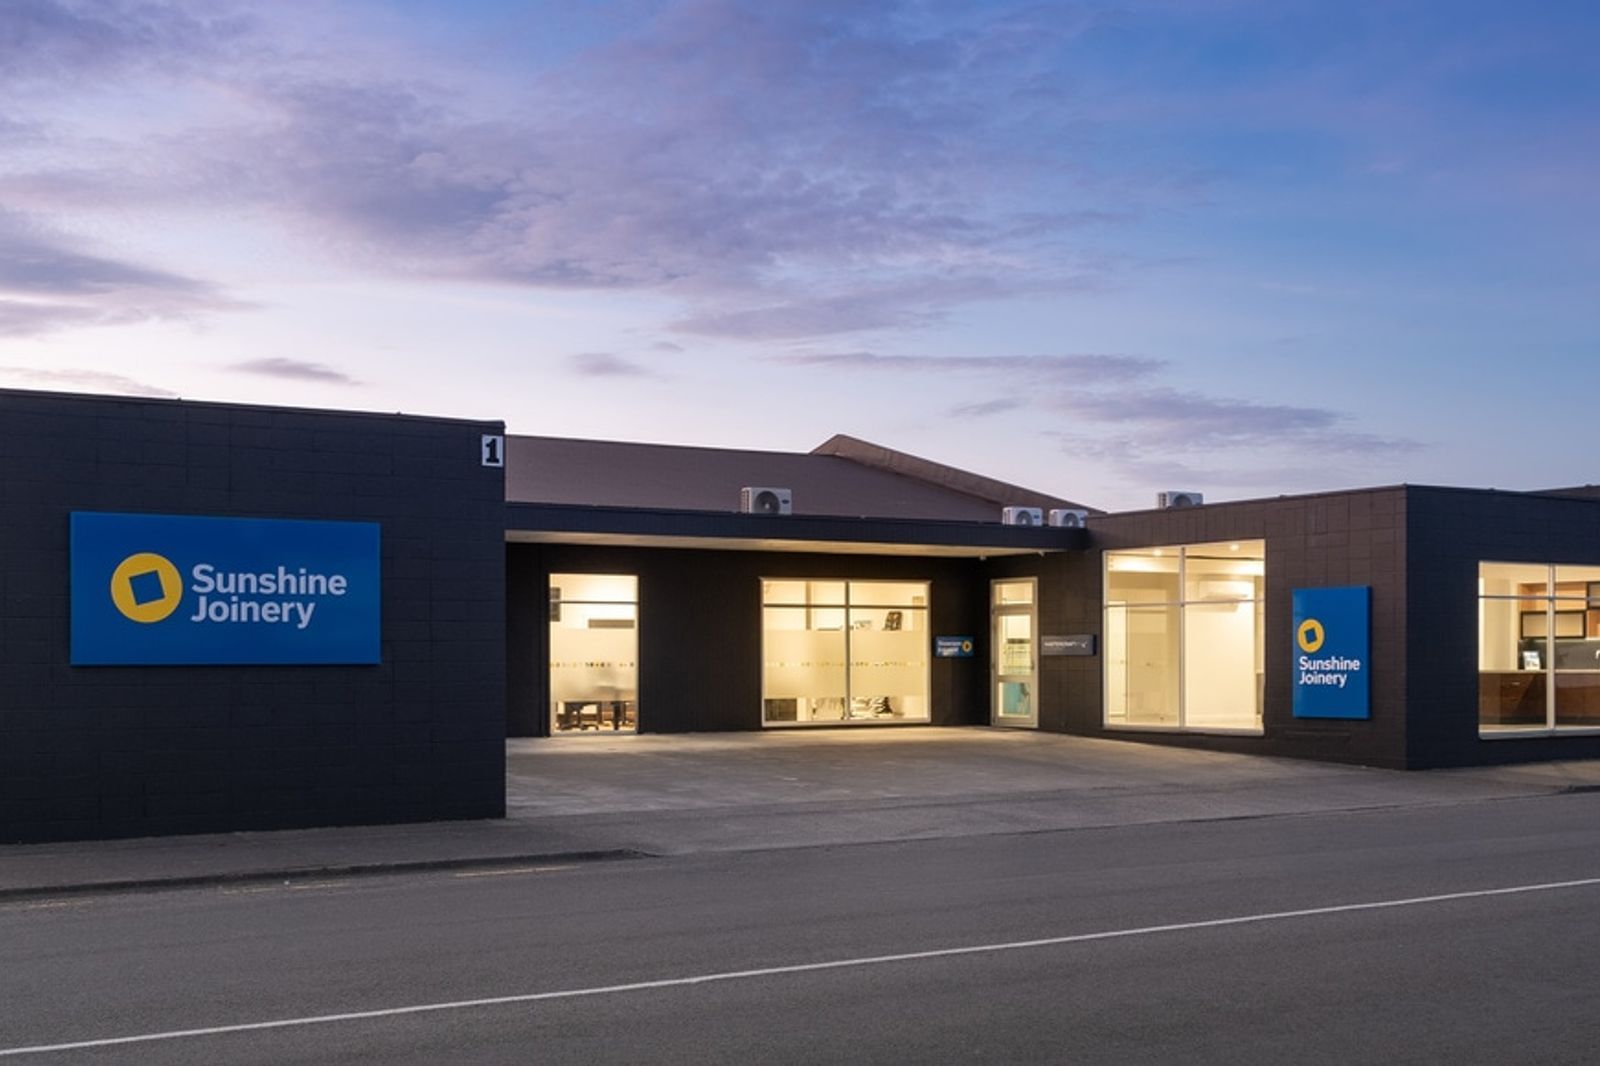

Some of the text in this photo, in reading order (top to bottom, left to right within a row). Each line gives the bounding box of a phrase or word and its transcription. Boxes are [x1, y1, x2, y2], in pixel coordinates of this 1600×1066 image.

[486, 437, 500, 464] 1
[191, 563, 348, 596] Sunshine
[190, 595, 316, 630] Joinery
[1299, 655, 1361, 671] Sunshine
[1299, 670, 1348, 689] Joinery
